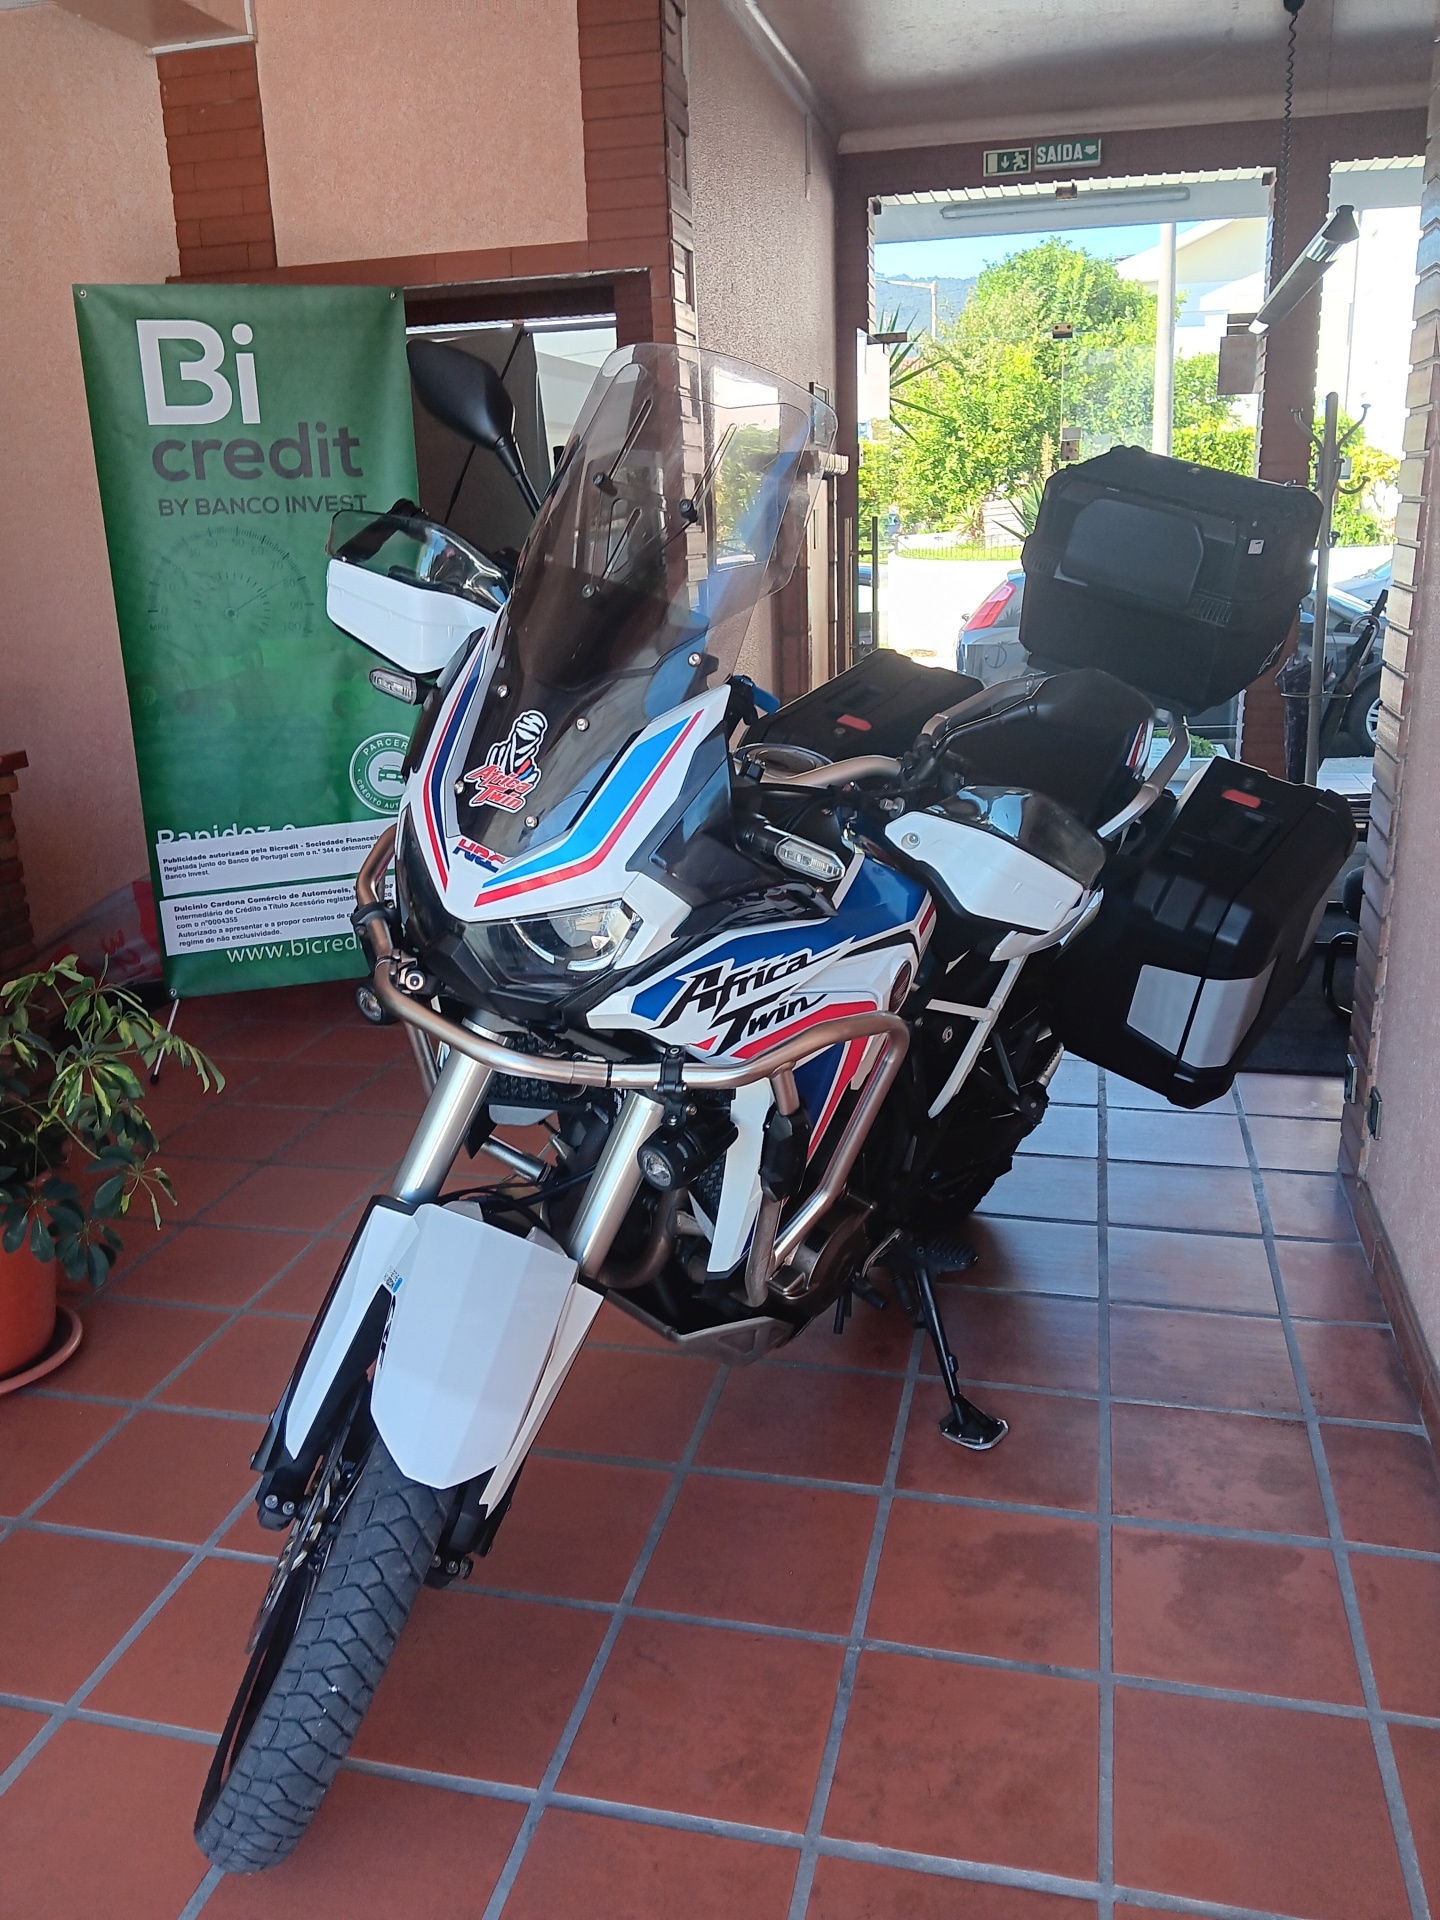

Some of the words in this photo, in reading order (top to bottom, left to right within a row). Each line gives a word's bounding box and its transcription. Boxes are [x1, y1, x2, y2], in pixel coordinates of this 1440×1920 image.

[136, 319, 261, 425] Bi
[152, 421, 364, 482] credit
[159, 498, 189, 517] BY
[196, 496, 280, 515] BANCO
[286, 495, 367, 513] INVEST
[468, 764, 534, 792] Africa
[472, 785, 524, 810] Twin
[163, 854, 207, 864] Publicidade
[209, 849, 249, 859] autorizada
[251, 847, 267, 856] pela
[269, 843, 299, 852] Bicredit
[305, 839, 344, 848] Sociedade
[164, 863, 197, 872] Registada
[199, 861, 216, 870] junto
[260, 852, 289, 862] Portugal
[342, 843, 372, 852] detentora
[165, 872, 186, 880] Banco
[174, 904, 208, 913] Dulcinio
[210, 899, 245, 908] Cardona
[247, 894, 287, 904] Comércio
[301, 887, 351, 898] Automóveis,
[175, 911, 223, 921] Intermediário
[235, 905, 261, 914] Crédito
[268, 902, 288, 910] Título
[290, 898, 325, 907] Acessório
[178, 929, 217, 938] Autorizado
[225, 922, 263, 934] apresentar
[277, 919, 300, 927] propor
[302, 915, 335, 923] contratos
[179, 938, 204, 947] regime
[232, 929, 282, 940] exclusividade.
[648, 949, 842, 1031] Africa
[708, 982, 828, 1058] Twin
